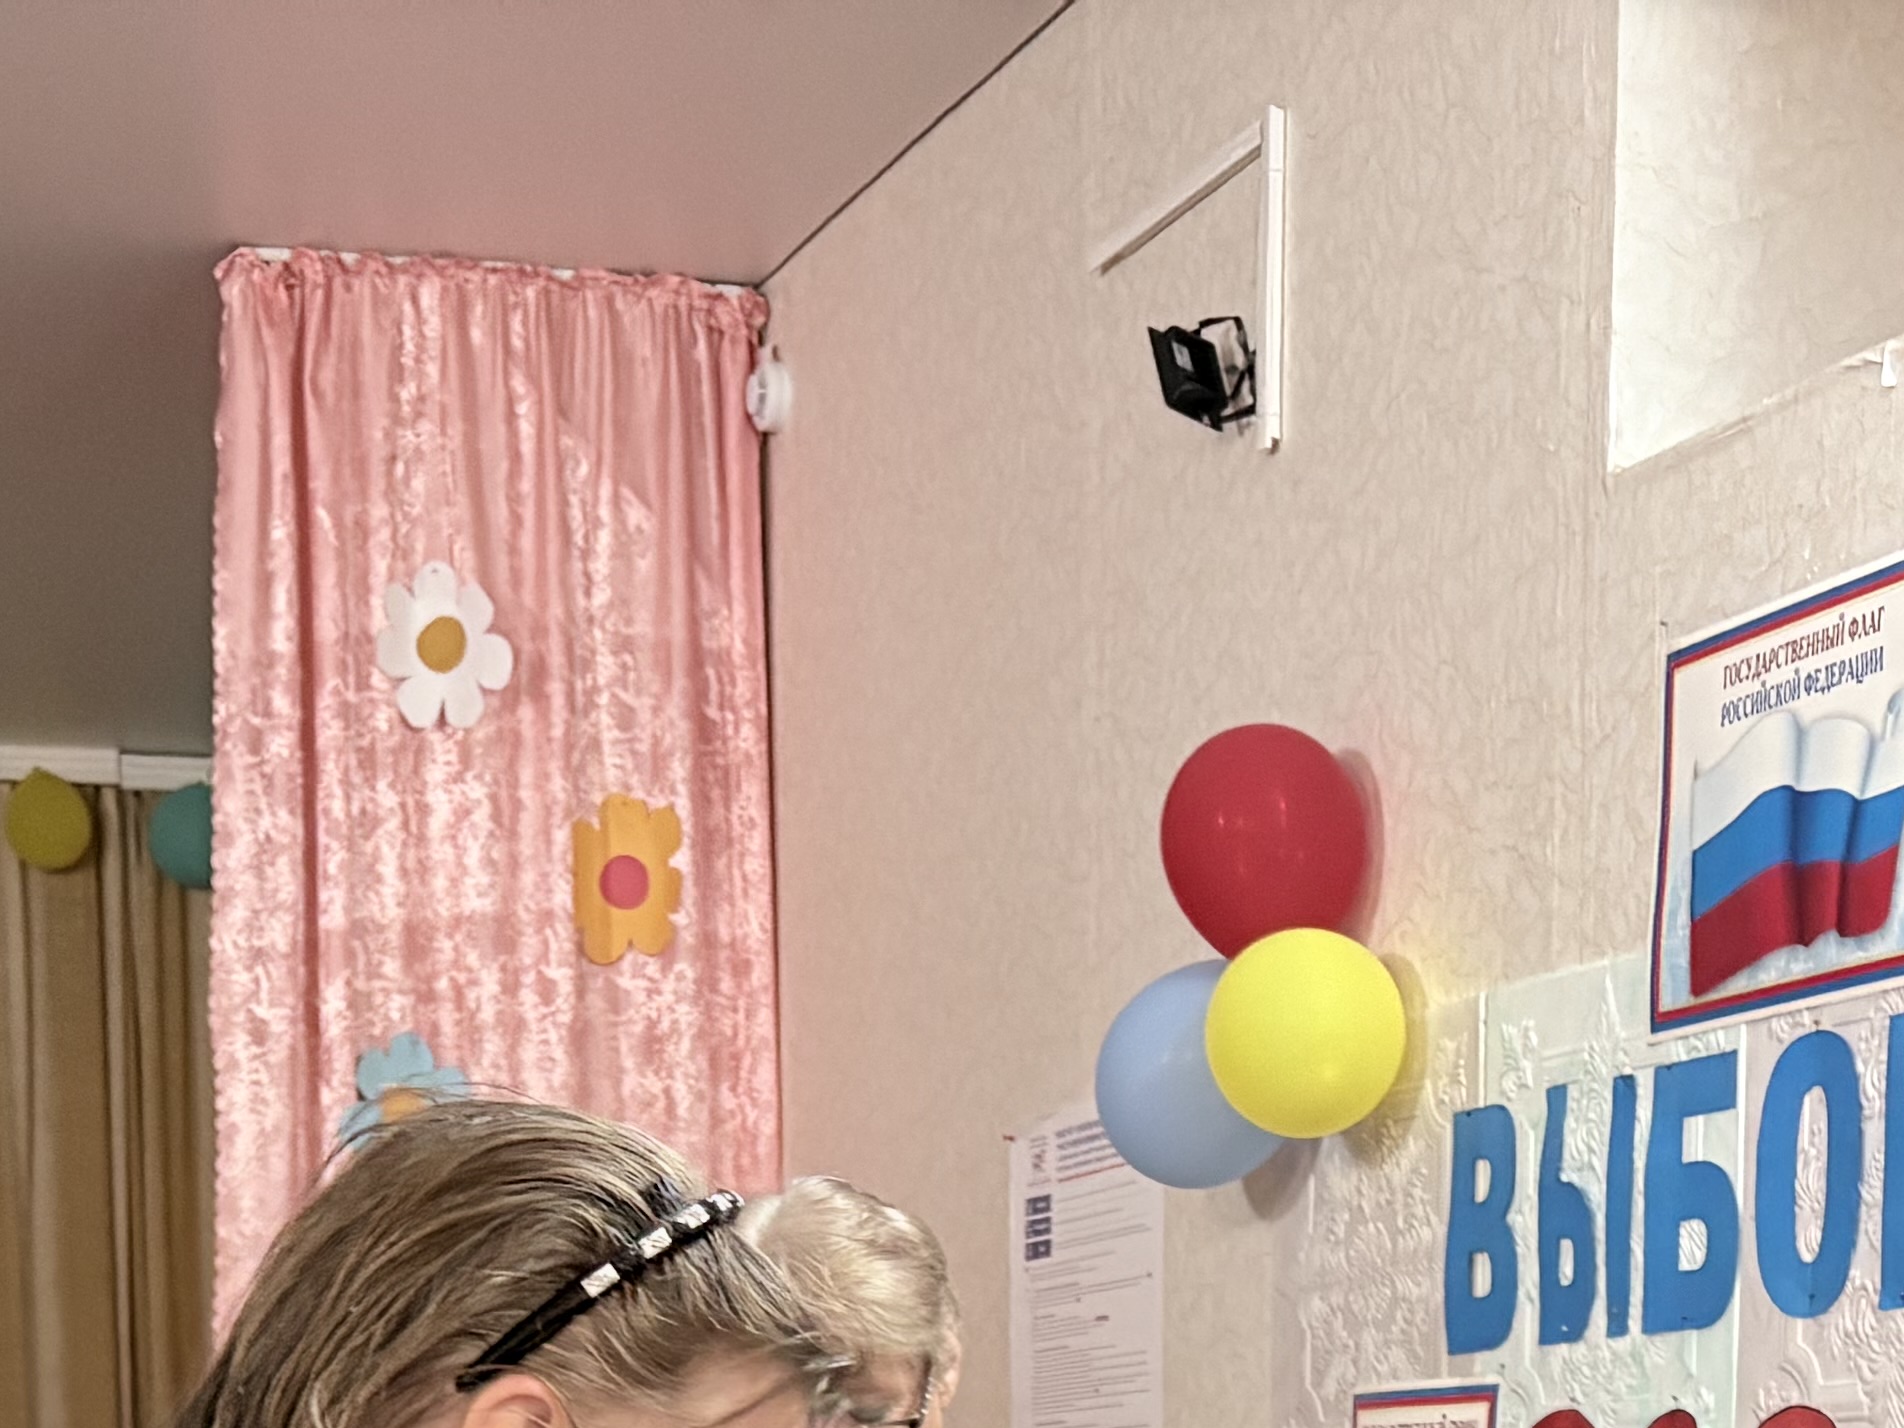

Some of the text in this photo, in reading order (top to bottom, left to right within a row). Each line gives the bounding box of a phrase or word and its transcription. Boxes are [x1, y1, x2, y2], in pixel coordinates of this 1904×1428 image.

[1720, 646, 1884, 727] РОССИЙСКОЙ ФЕДЕРАЦИИ
[1723, 606, 1885, 690] ГОСУДАРСТВЕННЫЙ ФЛАГ
